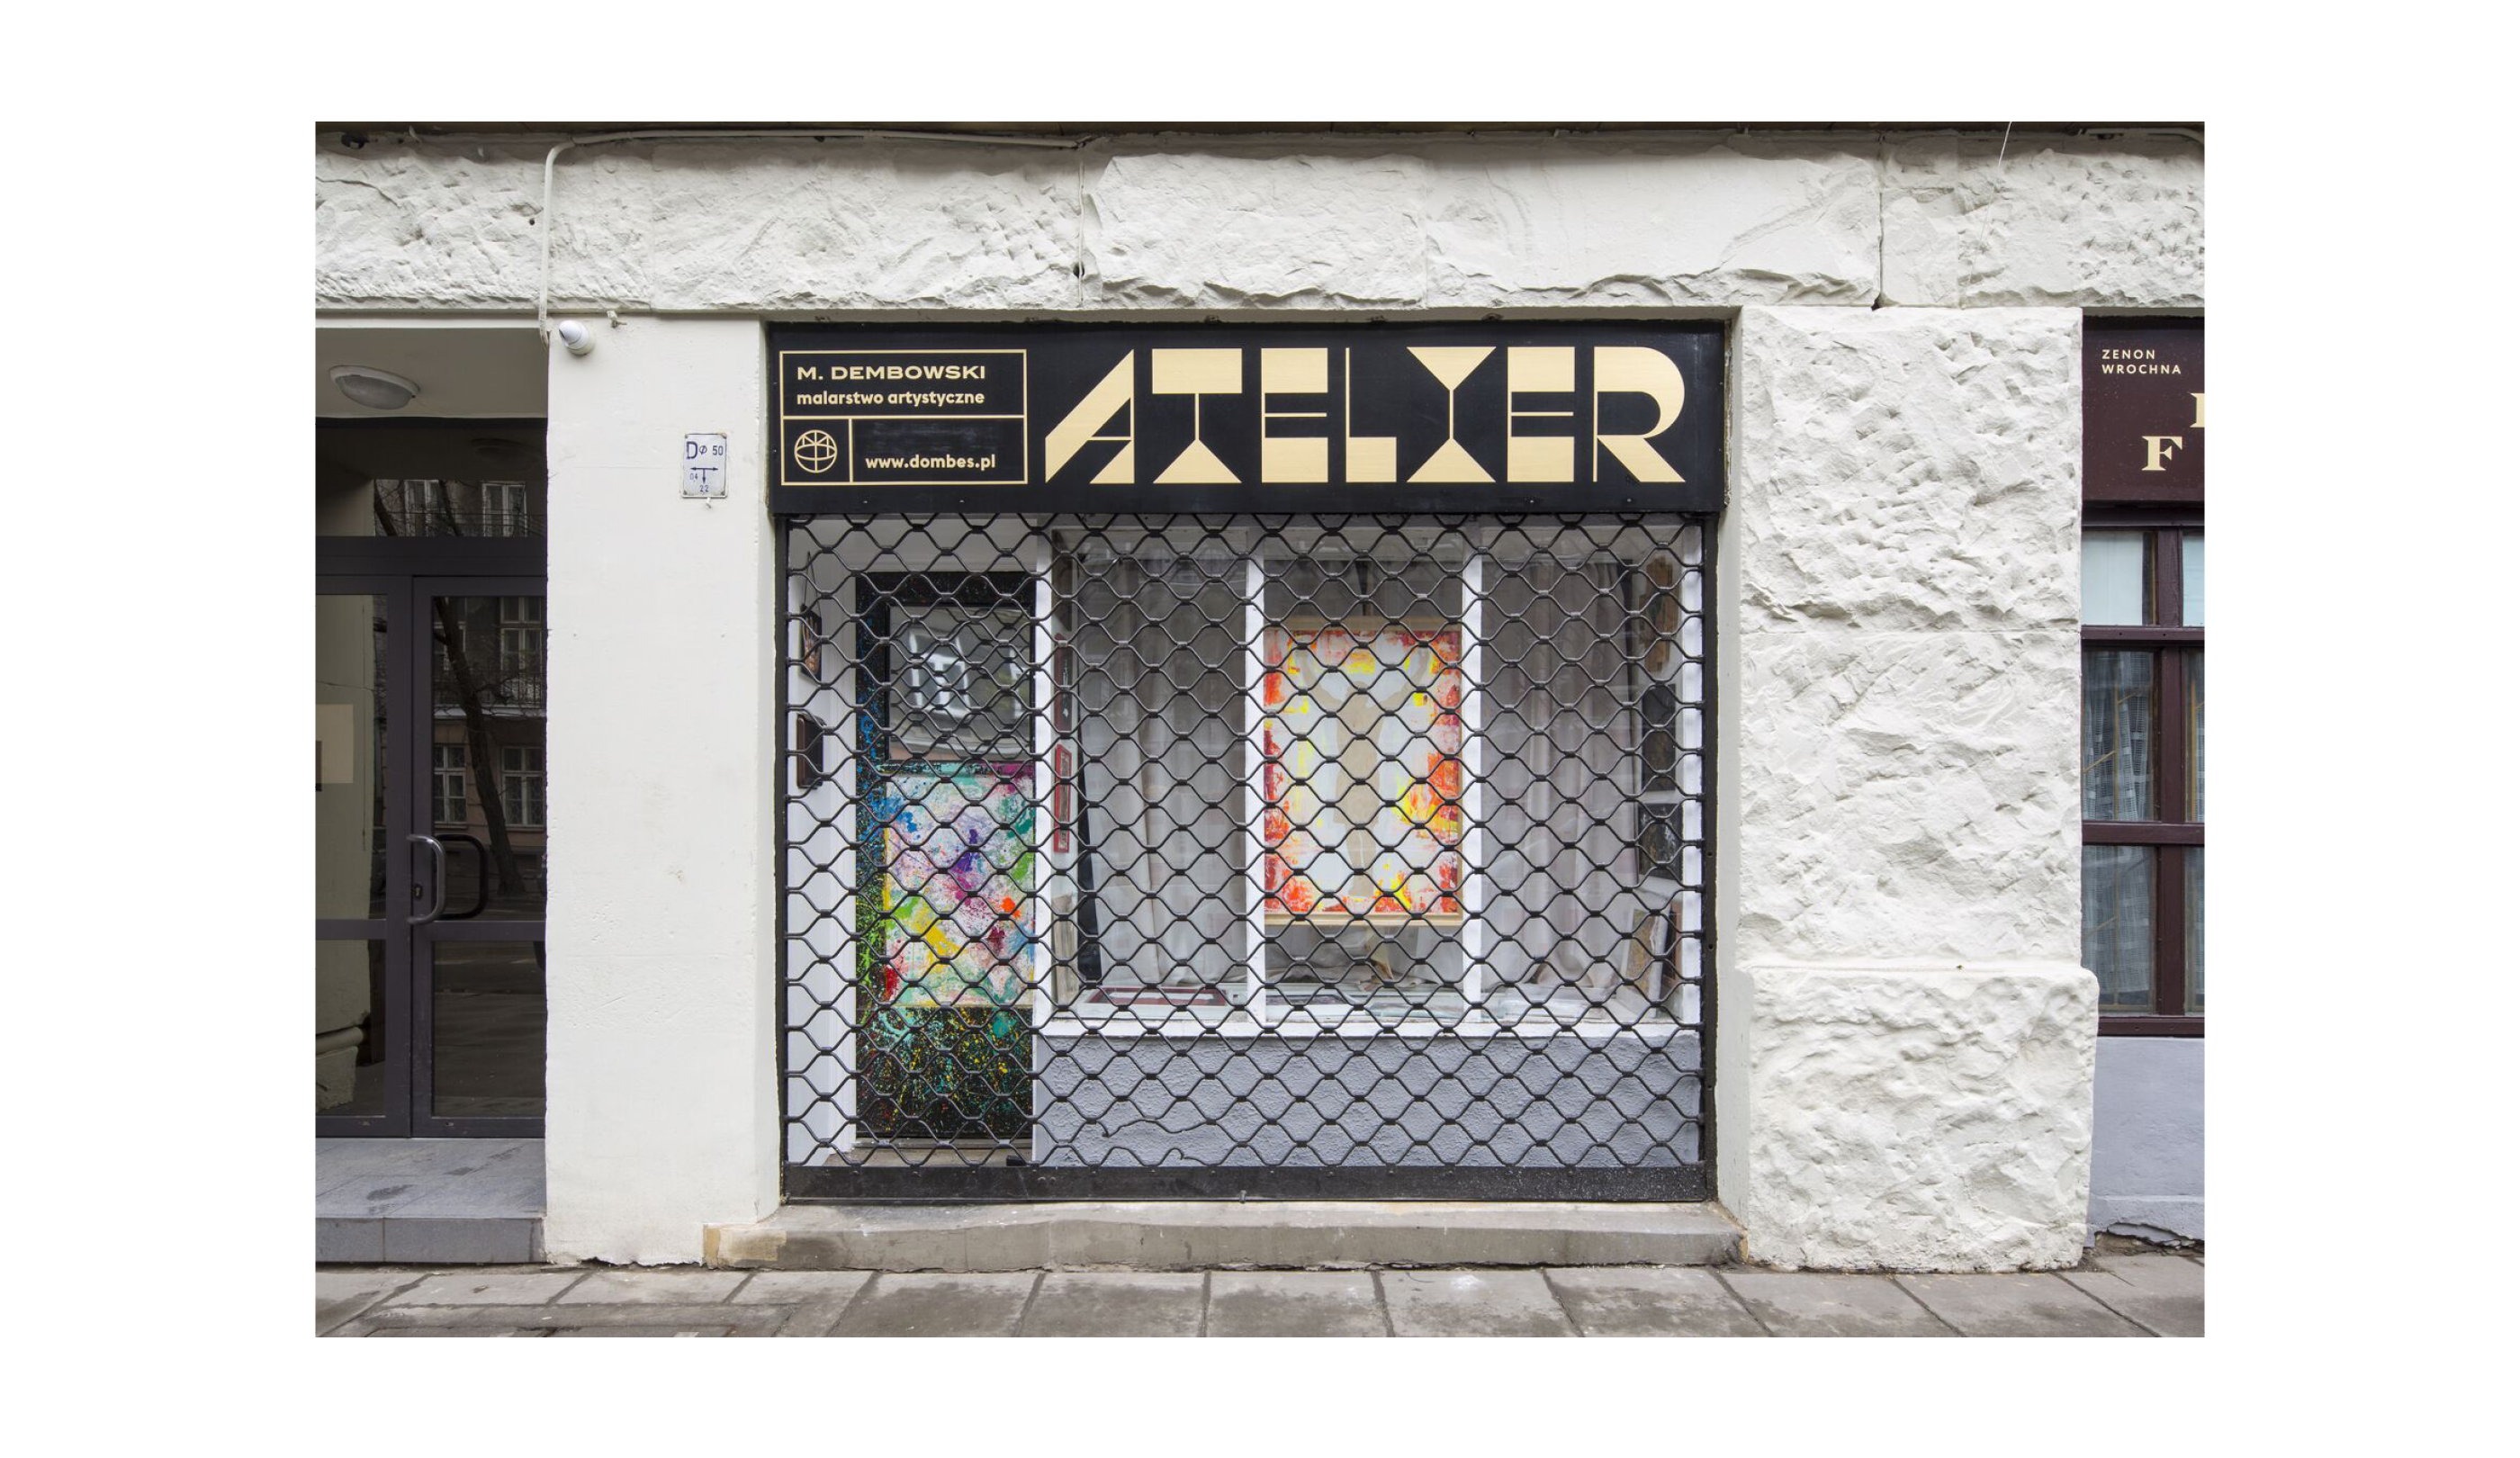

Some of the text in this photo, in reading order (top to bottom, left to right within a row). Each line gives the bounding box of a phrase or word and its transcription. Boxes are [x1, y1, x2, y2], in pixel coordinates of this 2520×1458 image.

[2102, 349, 2156, 360] ZENON
[797, 365, 986, 381] M. DEMBOWSKI
[2102, 364, 2182, 375] WROCHNA
[796, 391, 986, 407] malarstwo artystyczne
[1045, 346, 1686, 483] ATELIER
[712, 445, 724, 456] 50
[865, 454, 996, 472] www.dombes.pl
